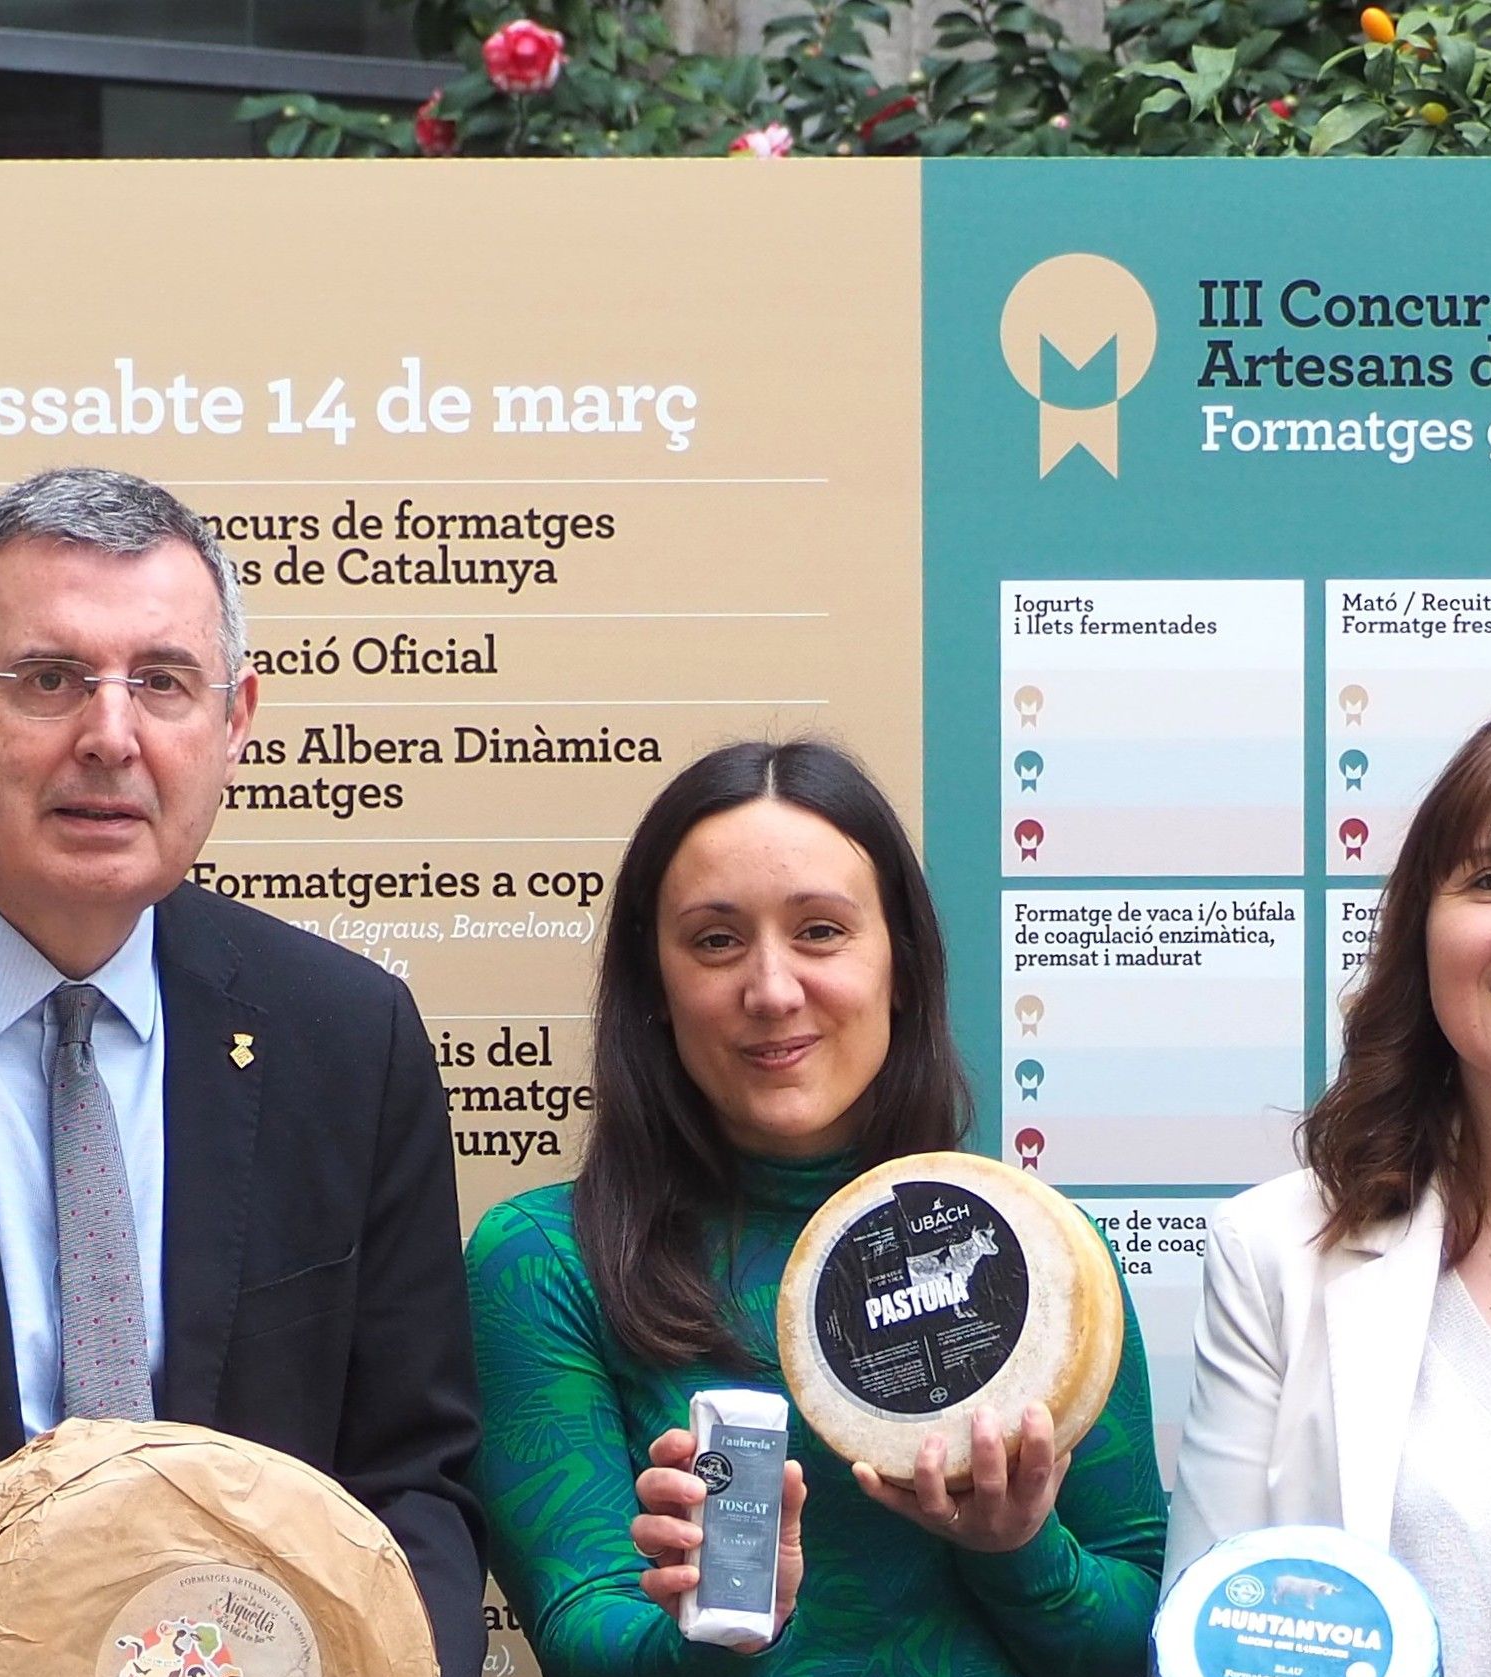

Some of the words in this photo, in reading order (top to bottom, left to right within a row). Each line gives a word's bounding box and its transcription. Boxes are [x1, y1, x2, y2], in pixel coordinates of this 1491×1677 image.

[1198, 280, 1262, 328] III
[1197, 339, 1456, 388] Artesans
[268, 376, 356, 445] 14
[377, 357, 472, 435] de
[492, 379, 698, 451] març
[1201, 405, 1474, 464] Formatges
[202, 513, 321, 542] ncurs
[331, 502, 383, 541] de
[394, 502, 616, 550] formatges
[274, 547, 324, 586] de
[336, 547, 558, 594] Catalunya
[1014, 594, 1094, 617] Iogurts
[1342, 592, 1398, 612] Mató
[1421, 593, 1491, 612] Recuit
[1014, 616, 1021, 635] i
[1026, 614, 1074, 635] llets
[1080, 614, 1218, 635] fermentades
[1342, 615, 1447, 639] Formatge
[352, 633, 498, 677] Oficial
[297, 727, 443, 767] Albera
[454, 724, 662, 767] Dinàmica
[191, 861, 480, 909] Formatgeries
[492, 870, 517, 898] a
[527, 869, 604, 908] cop
[328, 912, 445, 945] (12graus,
[450, 911, 596, 945] Barcelona)
[1014, 903, 1112, 925] Formatge
[1117, 901, 1141, 922] de
[1146, 908, 1194, 922] vaca
[1198, 901, 1228, 926] i/o
[1232, 901, 1296, 922] búfala
[1015, 924, 1039, 945] de
[1044, 924, 1153, 950] coagulació
[1158, 925, 1276, 947] enzimàtica,
[1014, 948, 1099, 971] premsat
[1103, 948, 1110, 966] i
[1115, 947, 1202, 967] madurat
[486, 1026, 552, 1067] del
[910, 1203, 971, 1233] UBACH
[1126, 1210, 1151, 1230] de
[1157, 1217, 1207, 1230] vaca
[1126, 1232, 1151, 1252] de
[865, 1273, 971, 1330] PASTURA
[717, 1499, 769, 1515] TOSCAT
[1208, 1606, 1382, 1650] MUNTANYOLA
